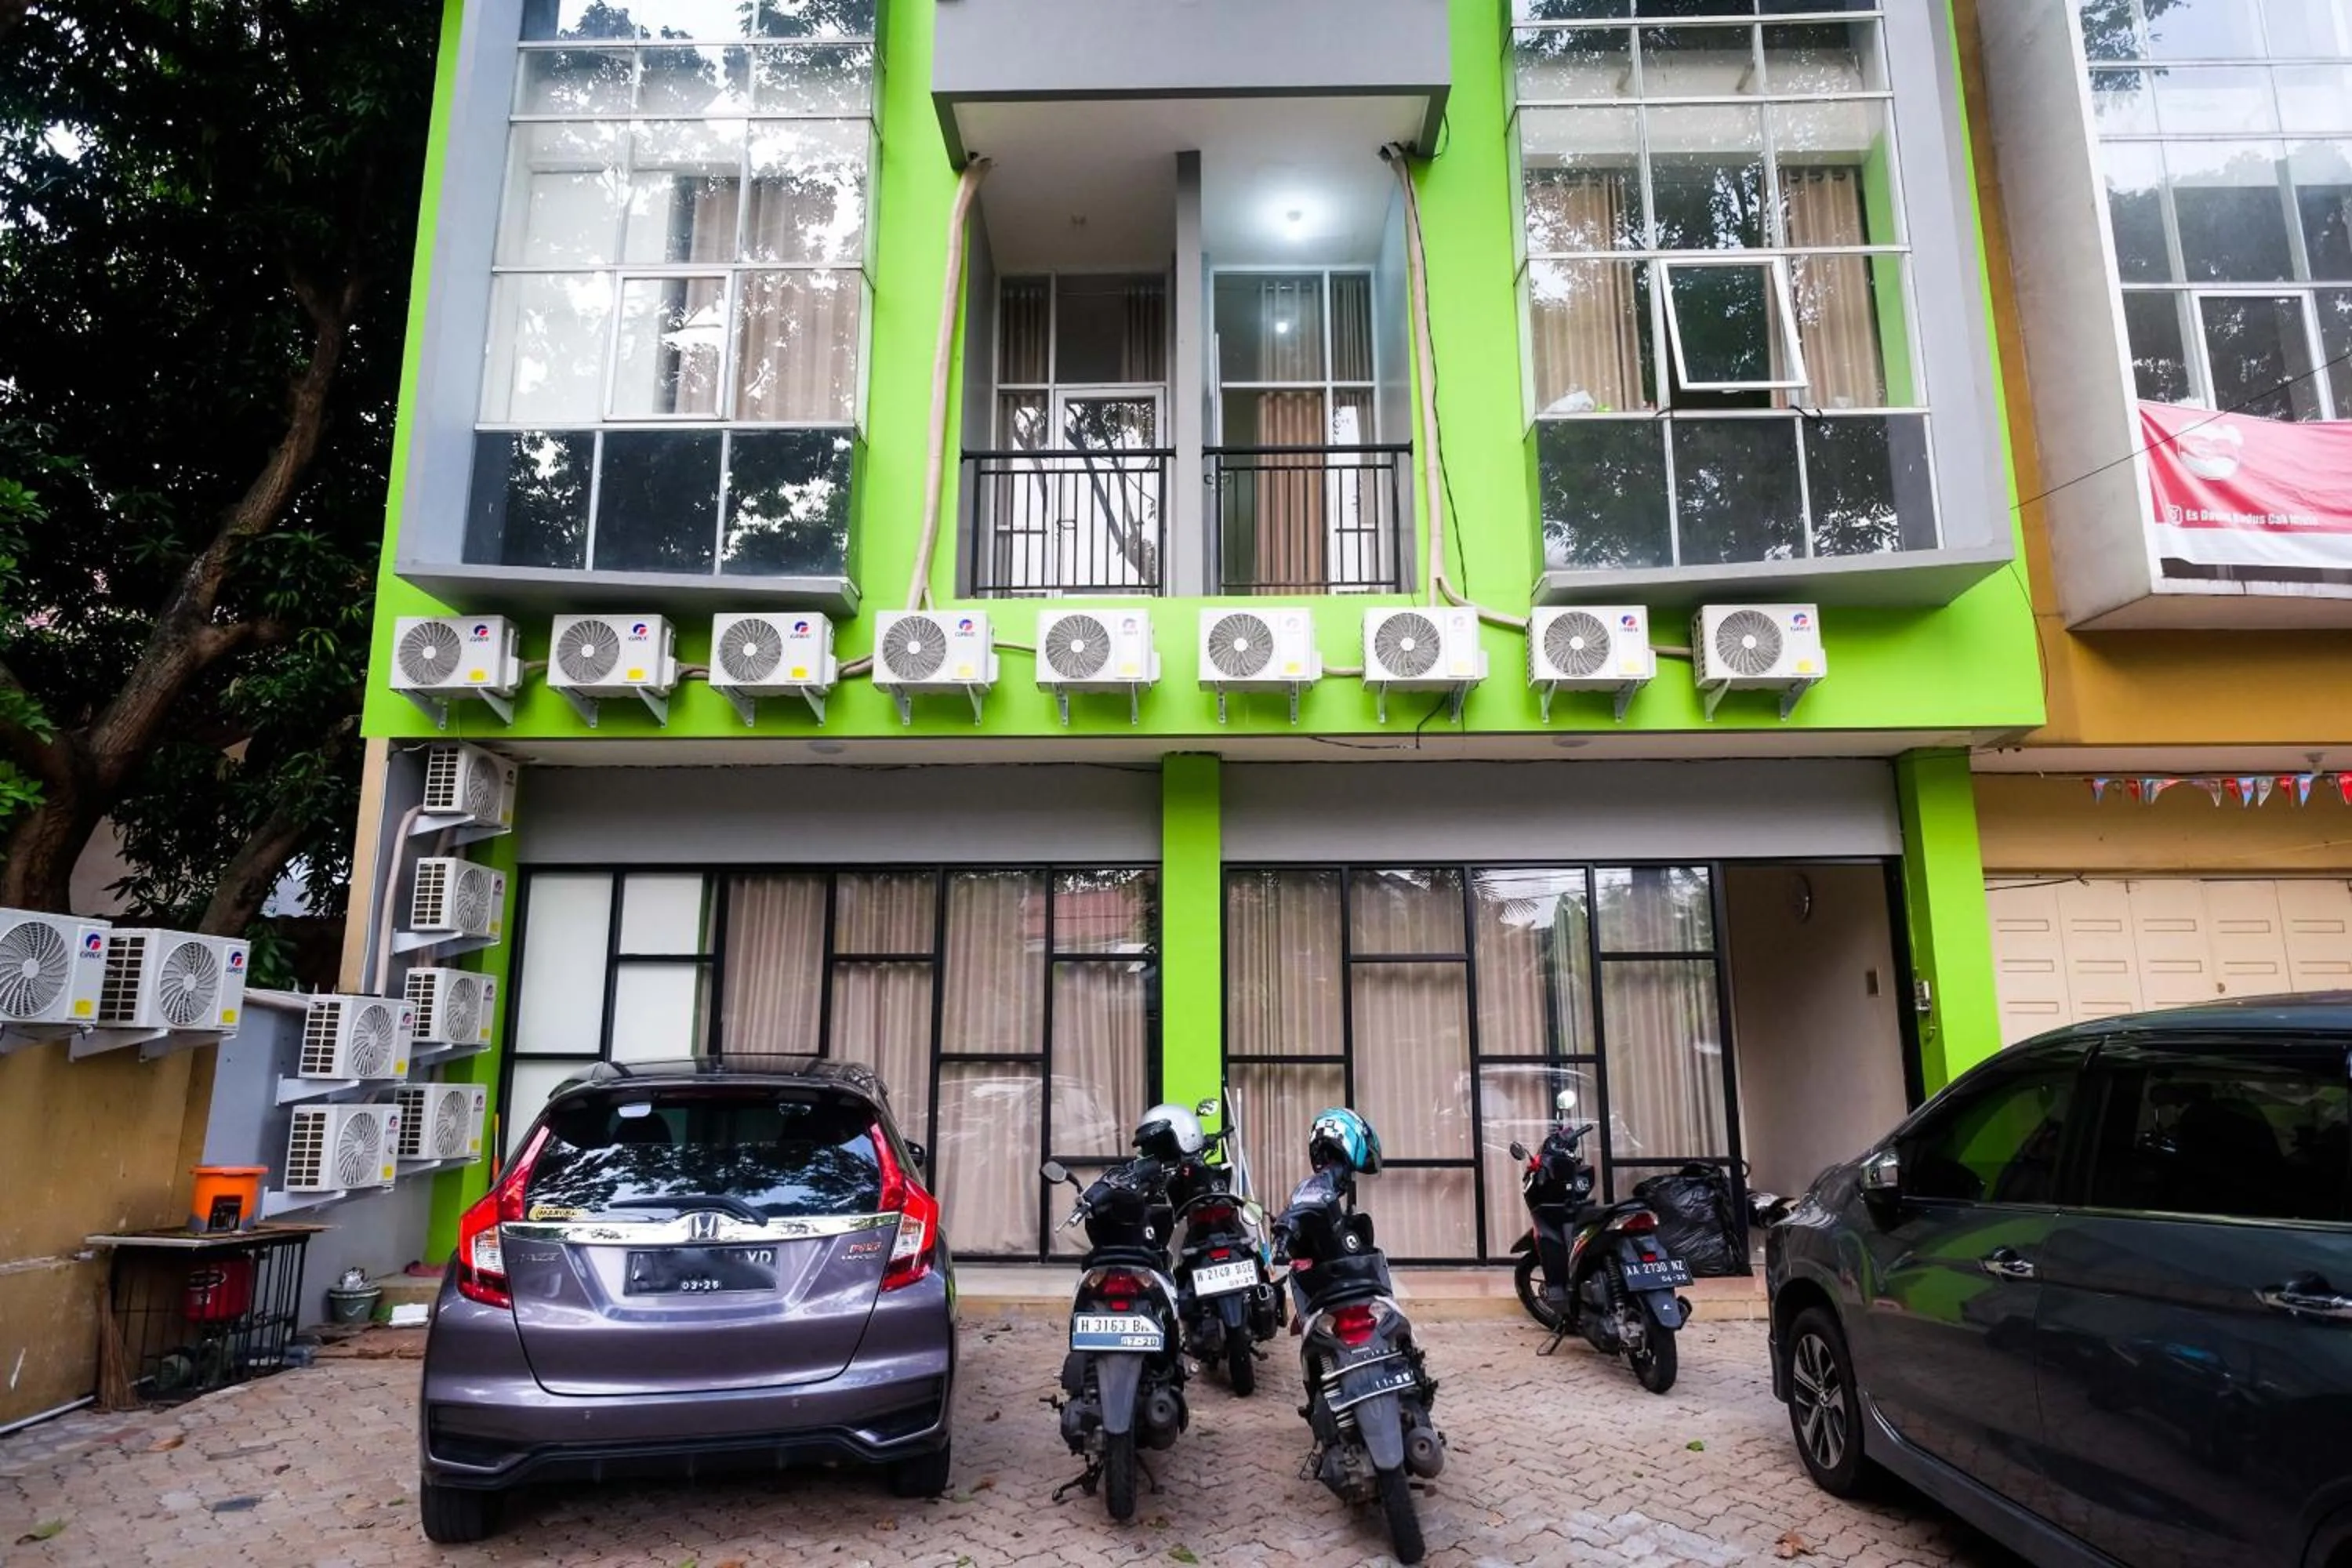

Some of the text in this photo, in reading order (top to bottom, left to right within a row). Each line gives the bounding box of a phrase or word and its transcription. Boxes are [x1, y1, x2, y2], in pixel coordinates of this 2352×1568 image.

[79, 951, 103, 960] GREE
[1625, 1265, 1639, 1277] AA
[1642, 1261, 1668, 1274] 2730
[1081, 1319, 1089, 1332] H
[1094, 1319, 1127, 1332] 3163
